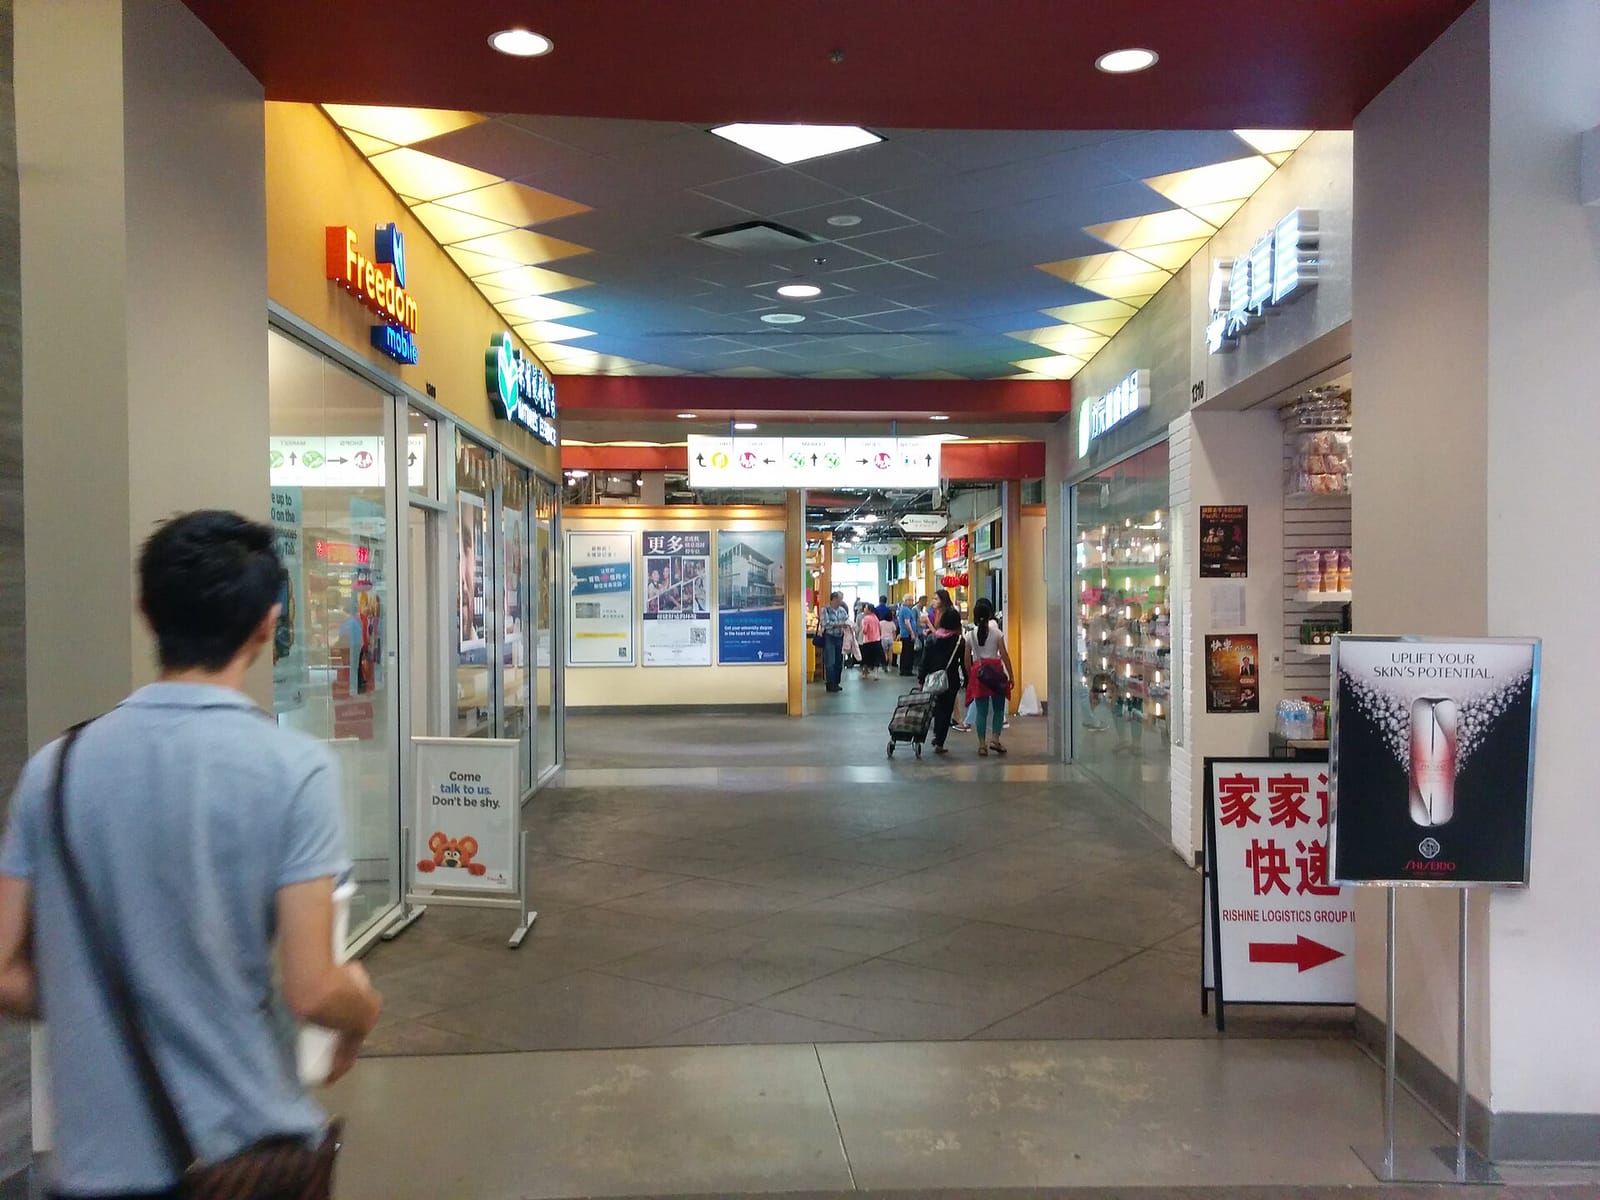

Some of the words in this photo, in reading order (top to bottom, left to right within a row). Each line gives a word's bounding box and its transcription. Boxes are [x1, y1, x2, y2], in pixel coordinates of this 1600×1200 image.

[346, 226, 418, 334] Freedom
[386, 326, 417, 365] mobile
[276, 494, 285, 507] up
[285, 493, 292, 506] to
[276, 510, 285, 521] on
[285, 508, 296, 523] the
[647, 535, 684, 555] 更多
[1392, 653, 1435, 664] UPLIFT
[1438, 653, 1475, 664] YOUR
[1373, 666, 1415, 678] SKIN'S
[1418, 667, 1495, 679] POTENTIAL.
[449, 771, 481, 782] Come
[440, 783, 460, 794] talk
[463, 784, 474, 794] to
[477, 786, 492, 795] us.
[432, 796, 461, 807] Don't
[463, 796, 477, 807] be
[480, 797, 501, 810] shy.
[1218, 773, 1328, 829] 家家
[1401, 860, 1456, 871] SHISEIDO
[1222, 909, 1259, 921] RISHINE
[1262, 910, 1311, 922] LOGISTICS
[1314, 910, 1347, 922] GROUP
